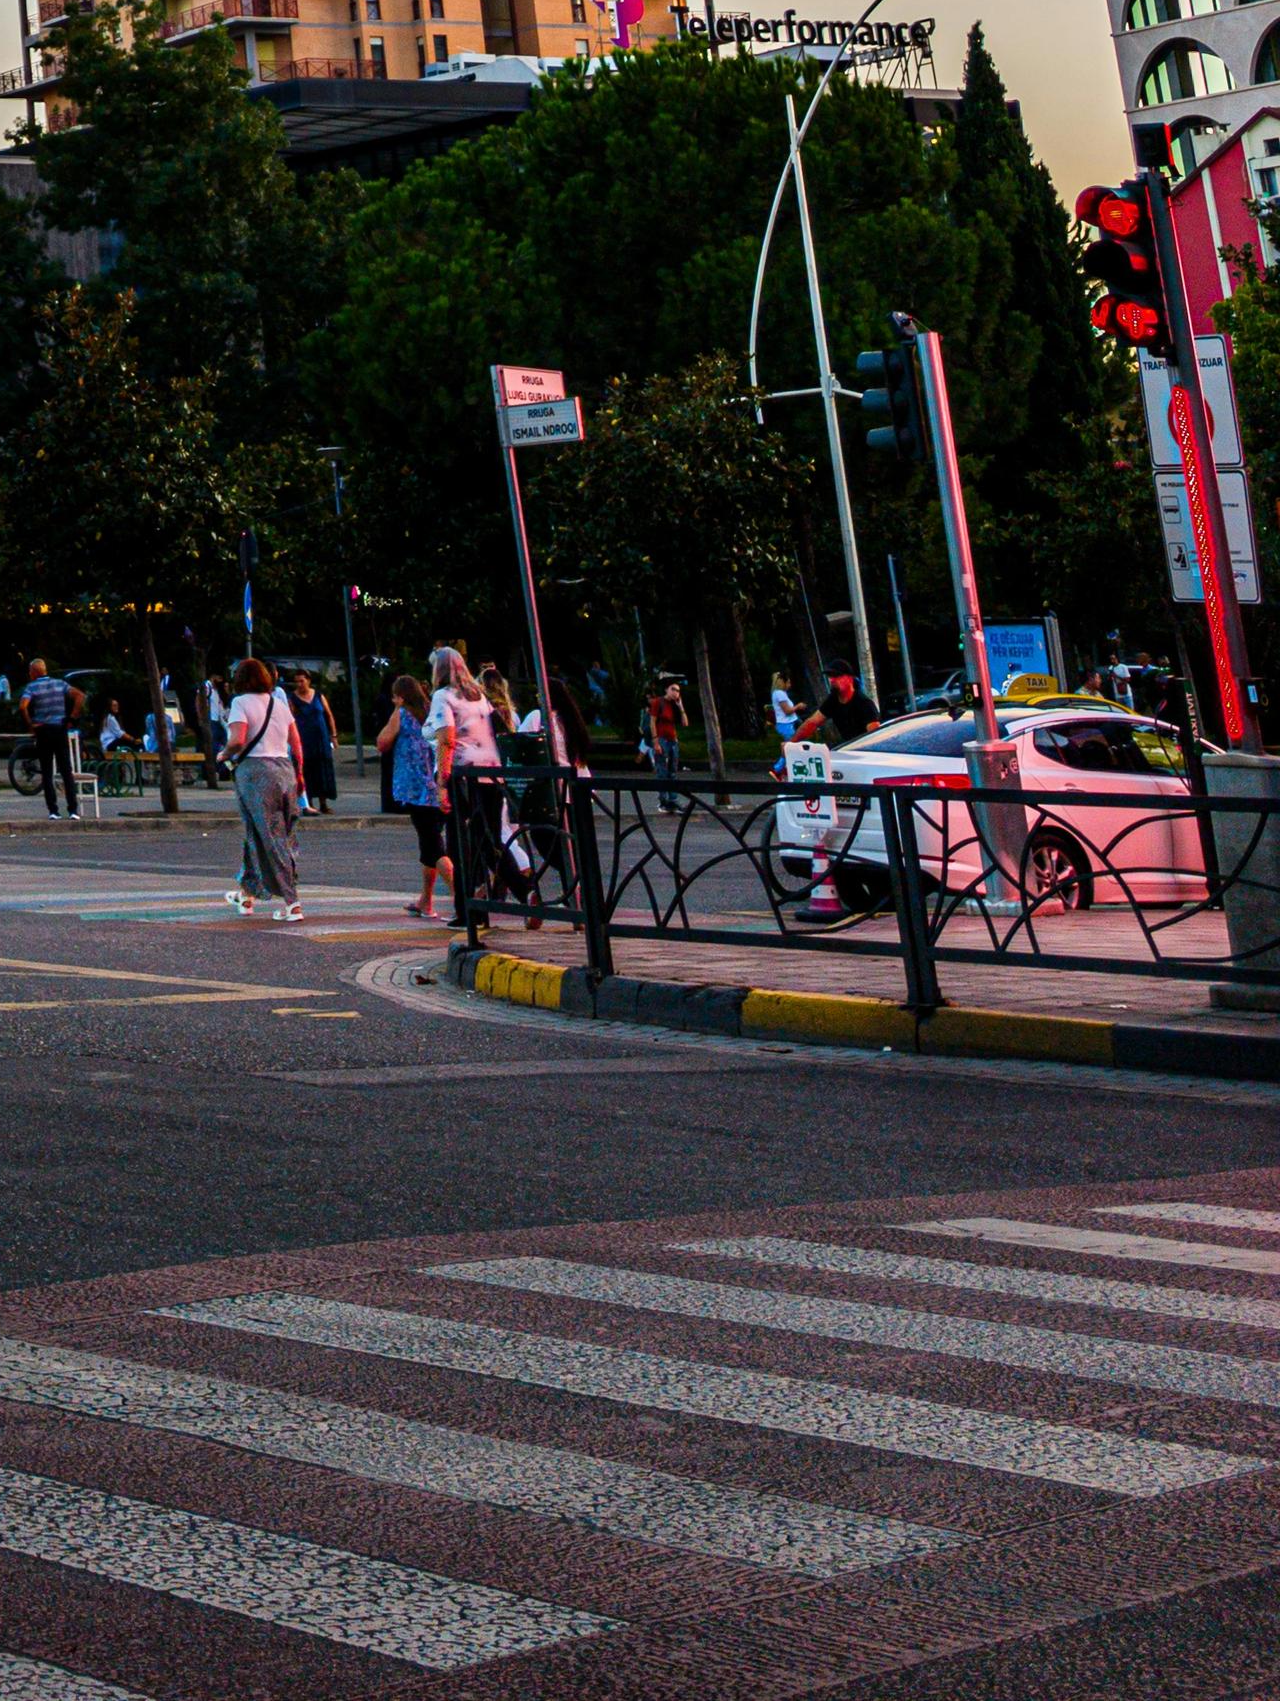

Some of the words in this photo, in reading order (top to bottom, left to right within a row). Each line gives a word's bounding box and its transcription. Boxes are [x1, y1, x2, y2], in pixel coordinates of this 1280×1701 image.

[668, 6, 928, 47] Teleperformance
[1143, 360, 1168, 371] TRAFI
[522, 375, 544, 386] RRUGA
[508, 390, 527, 401] LUIGJ
[527, 407, 555, 419] RRUGA
[512, 427, 541, 439] ISMAIL
[543, 422, 577, 436] NDROQI
[1026, 678, 1047, 686] TAXI
